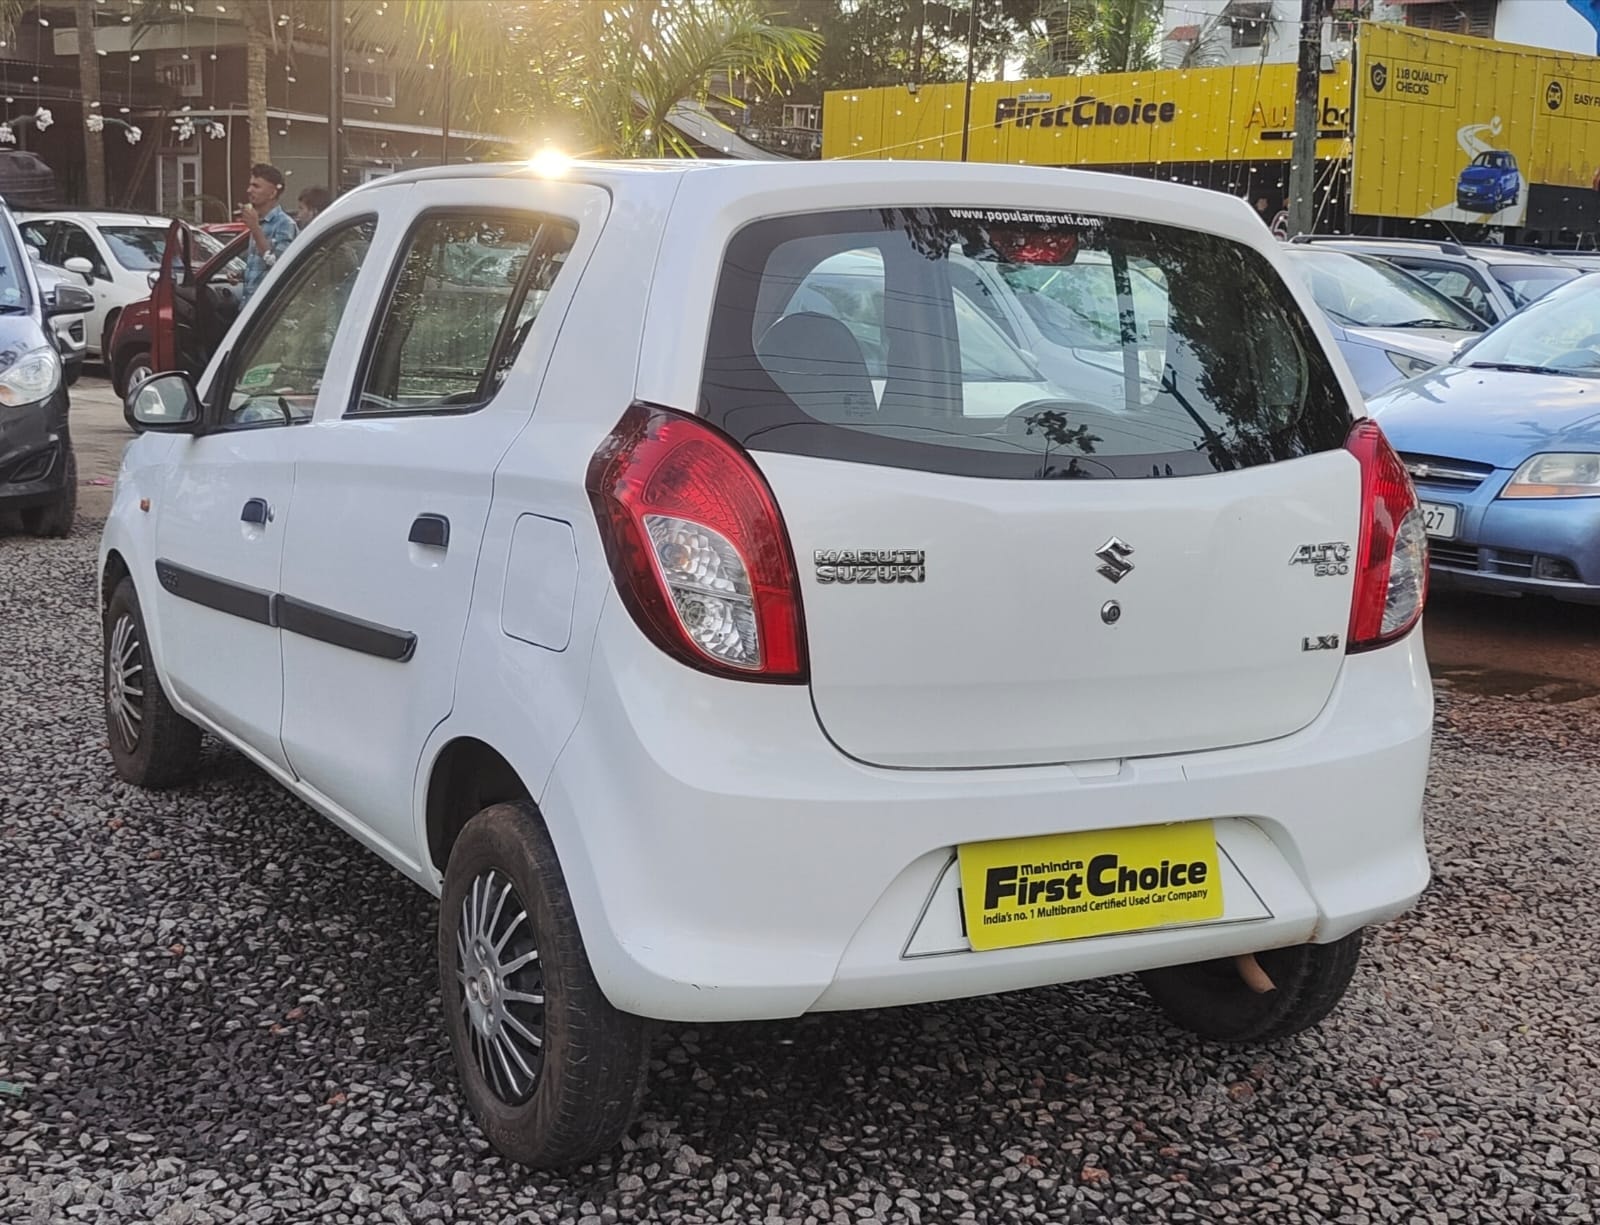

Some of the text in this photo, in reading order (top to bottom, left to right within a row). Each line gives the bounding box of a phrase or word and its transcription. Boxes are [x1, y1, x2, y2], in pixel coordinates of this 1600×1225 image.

[1411, 70, 1448, 84] QUALITY
[1396, 81, 1429, 95] CHECKS
[1574, 93, 1593, 106] EASY
[949, 209, 1101, 227] www.popularmaruti.com
[1422, 509, 1445, 530] 27
[813, 549, 925, 566] MARUTI
[815, 565, 925, 584] SUZUKI
[1021, 860, 1083, 876] Mahindra
[1014, 912, 1028, 921] no.
[1030, 909, 1034, 918] 1
[1037, 901, 1088, 918] Multibrand
[1089, 897, 1127, 911] Certified
[1129, 894, 1150, 906] Used
[1152, 892, 1166, 903] Car
[1168, 888, 1208, 902] Company
